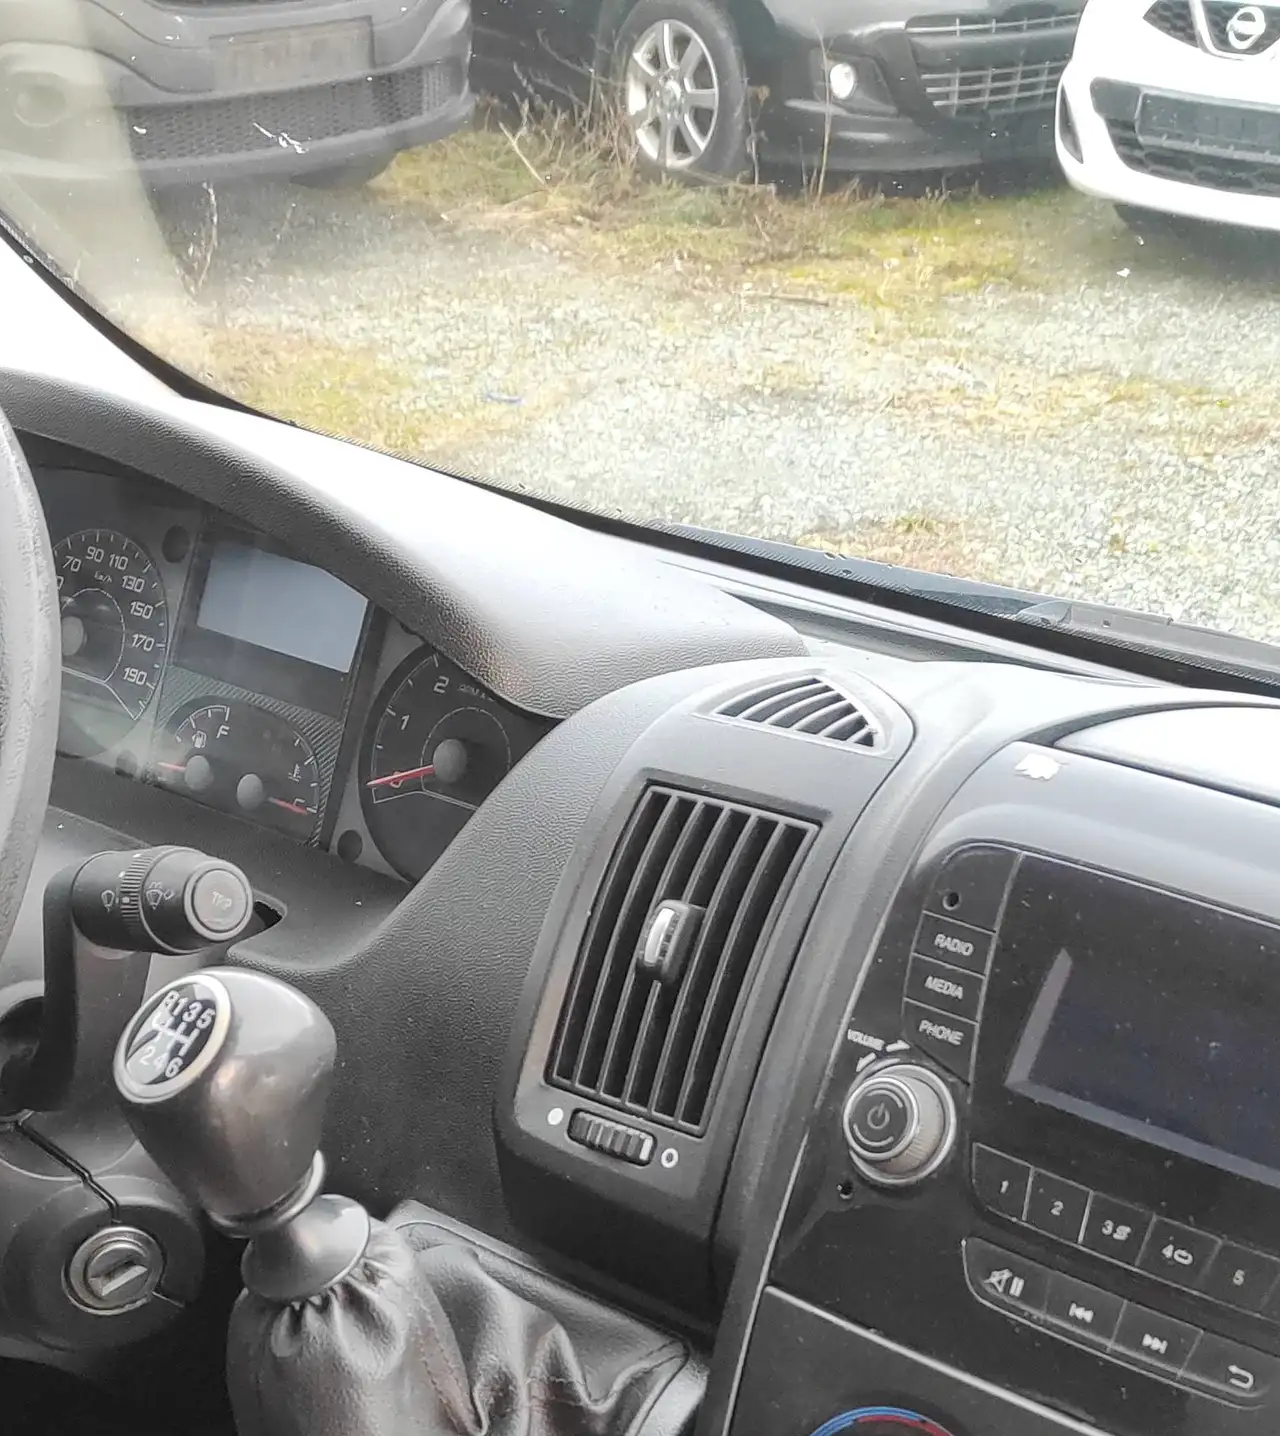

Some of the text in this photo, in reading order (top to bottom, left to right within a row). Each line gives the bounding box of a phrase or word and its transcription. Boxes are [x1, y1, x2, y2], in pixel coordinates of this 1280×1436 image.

[86, 546, 105, 563] 90
[109, 553, 128, 571] 110
[62, 556, 82, 572] 70
[121, 575, 145, 593] 130
[130, 601, 154, 619] 150
[131, 633, 155, 652] 170
[123, 667, 148, 686] 190
[433, 675, 450, 693] 2
[400, 714, 410, 730] 1
[216, 724, 230, 739] F
[934, 933, 974, 956] RADIO
[924, 975, 964, 1000] MEDIA
[847, 1028, 885, 1051] VOLUME
[919, 1019, 964, 1046] PHONE
[1000, 1180, 1009, 1194] 1
[1050, 1201, 1064, 1216] 2
[1101, 1219, 1114, 1235] 3
[1161, 1244, 1174, 1260] 4
[1232, 1269, 1245, 1286] 5
